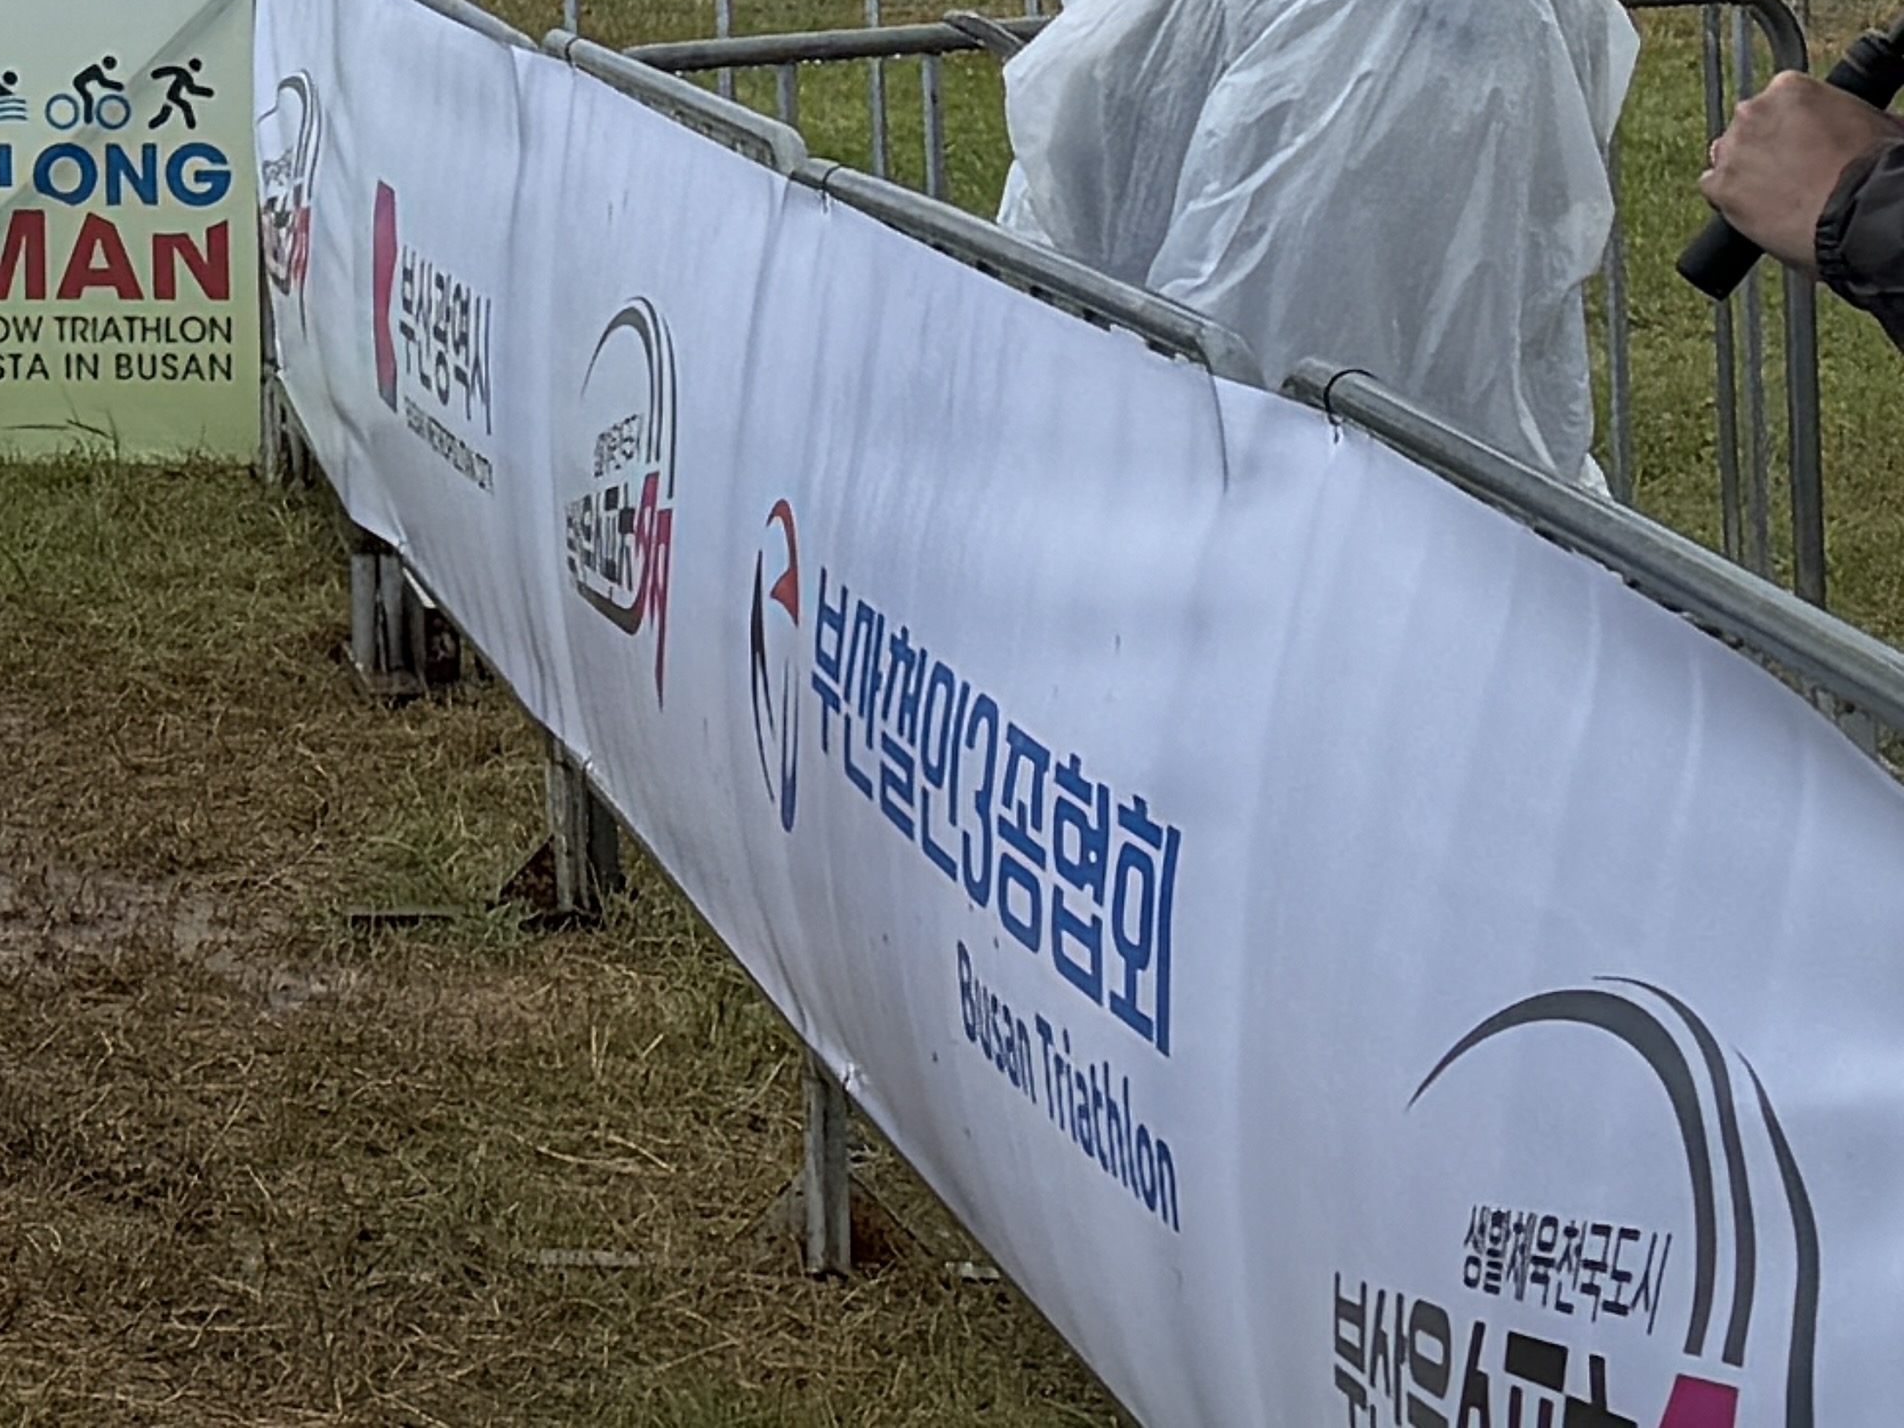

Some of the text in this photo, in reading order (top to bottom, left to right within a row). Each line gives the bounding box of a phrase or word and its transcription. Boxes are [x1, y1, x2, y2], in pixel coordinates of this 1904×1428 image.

[54, 315, 232, 343] TRIATHLON
[66, 353, 99, 380] IN
[116, 353, 232, 381] BUSAN
[812, 567, 1181, 1056] 부산철인3종협회
[958, 942, 1180, 1232] Busan Triathlon
[1463, 1203, 1672, 1335] 생활체육천국도시
